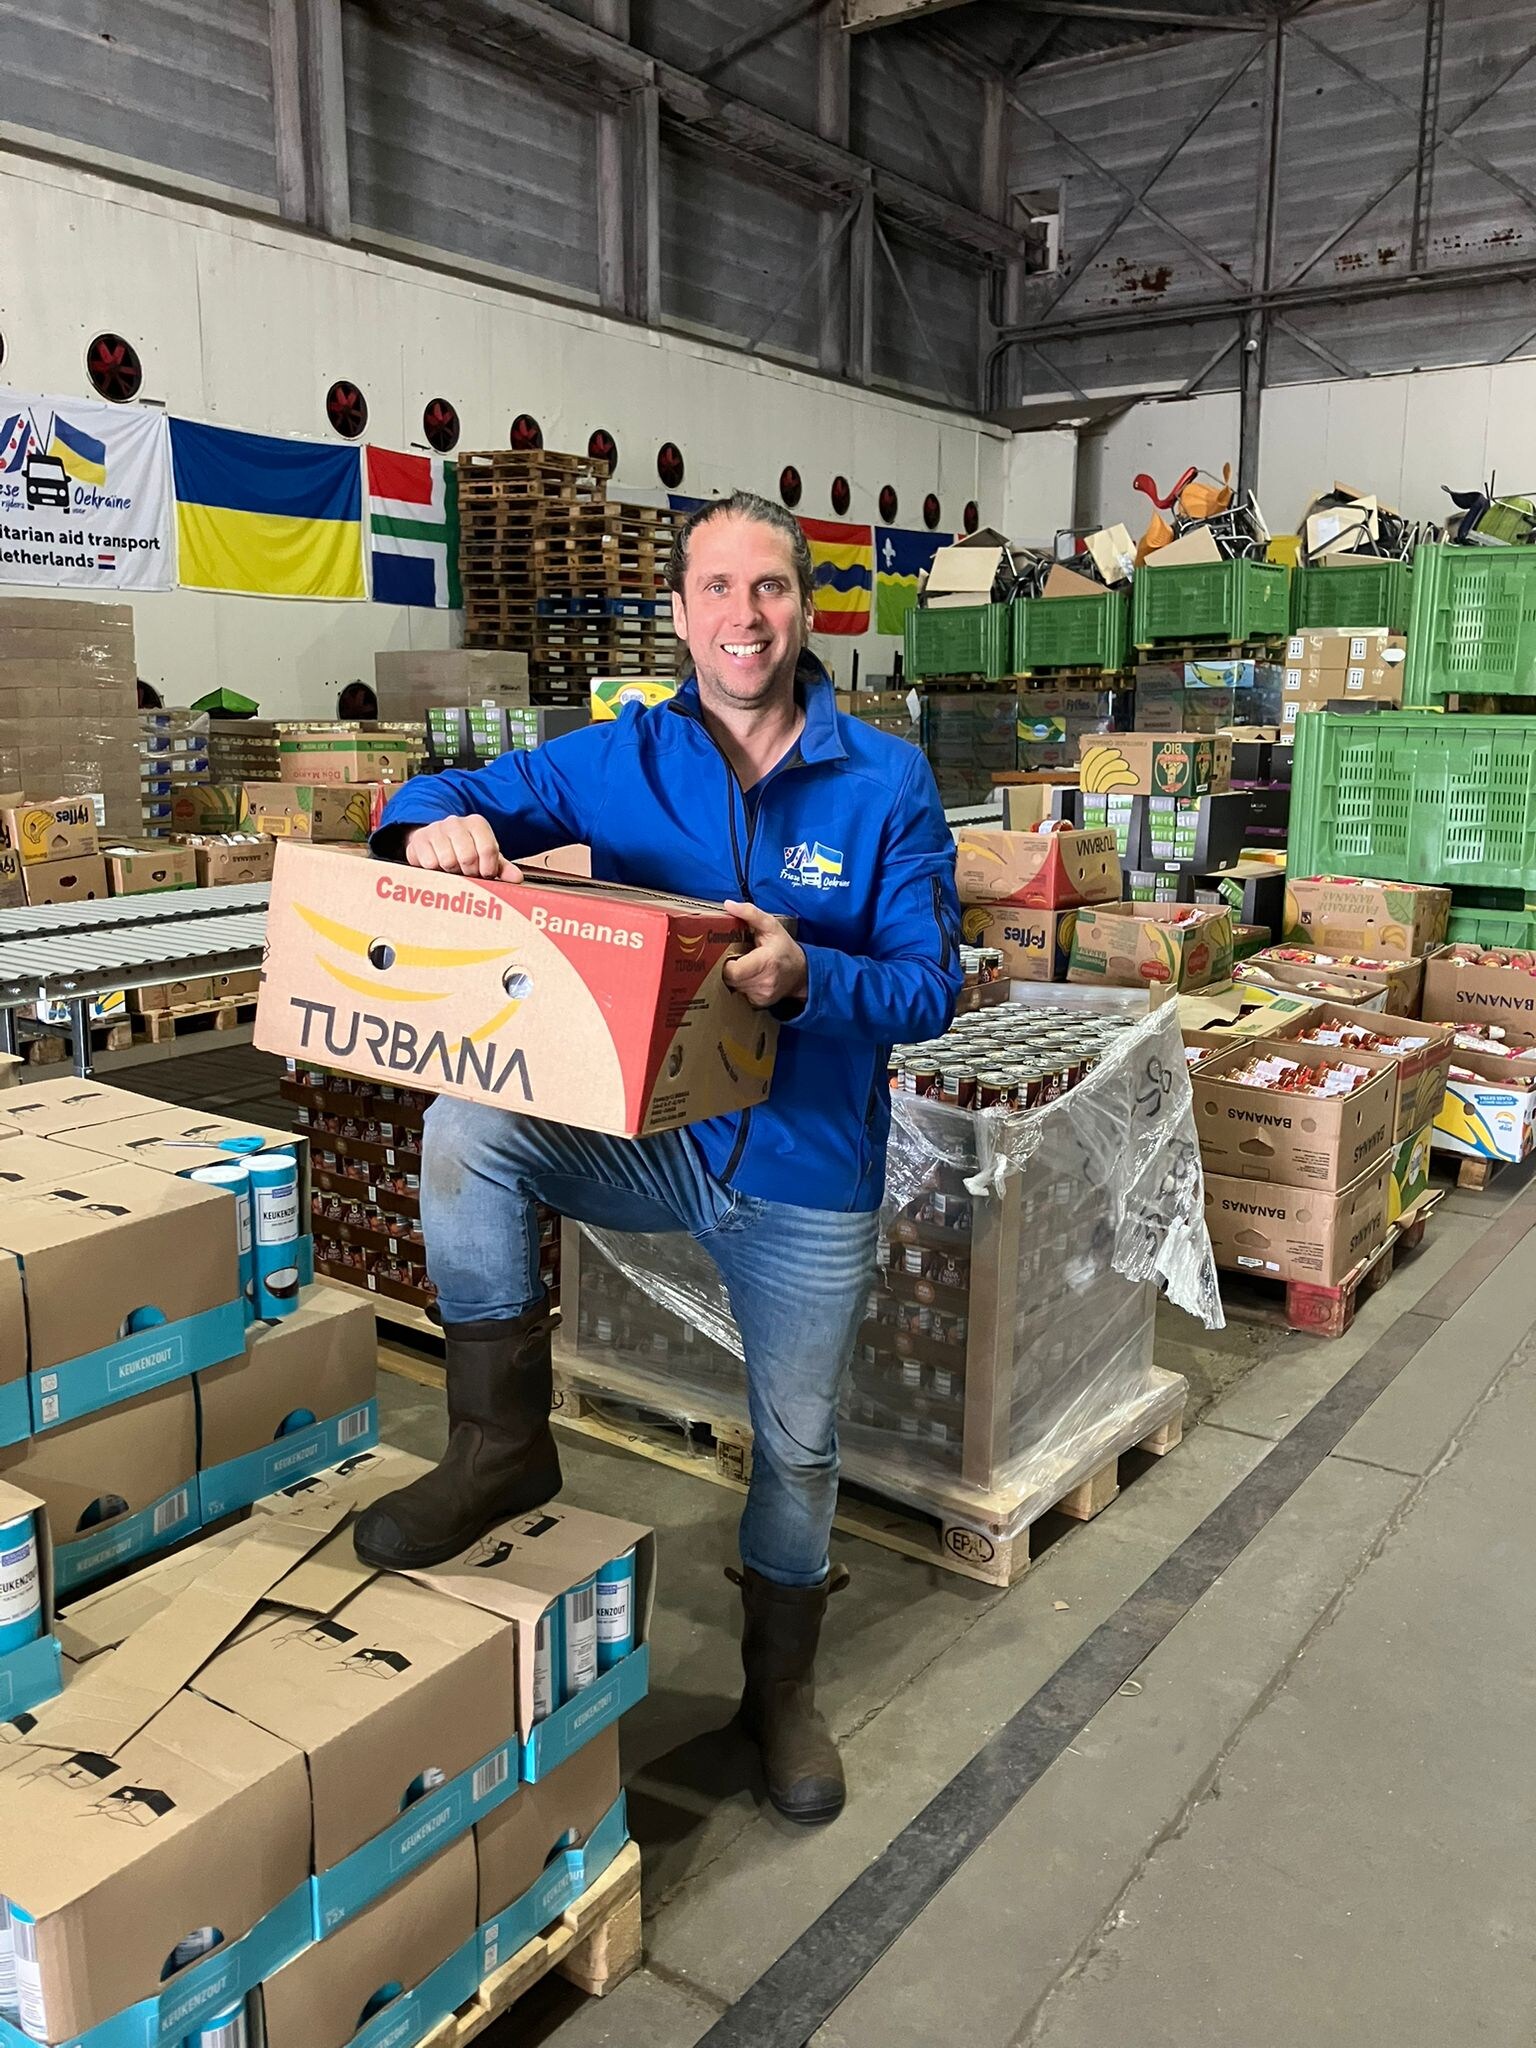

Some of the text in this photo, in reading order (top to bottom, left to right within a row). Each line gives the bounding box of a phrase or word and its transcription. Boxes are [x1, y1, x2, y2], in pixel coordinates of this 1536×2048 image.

[74, 486, 132, 509] Oekraïne
[59, 529, 84, 545] aid
[88, 532, 160, 551] transport
[0, 549, 95, 568] etherlands
[1163, 742, 1182, 754] BIO
[375, 875, 645, 951] Cavendish Bananas
[1456, 990, 1535, 1011] BANANAS
[290, 997, 534, 1102] TURBANA
[1228, 1107, 1293, 1130] BANANAS
[1221, 1199, 1287, 1221] BANANAS
[118, 1347, 173, 1379] KEUKENZOUT
[273, 1443, 320, 1473] KEUKENZOUT
[400, 1806, 452, 1854] KEUKENZOUT
[161, 1975, 228, 2032] KEUKENZOUT
